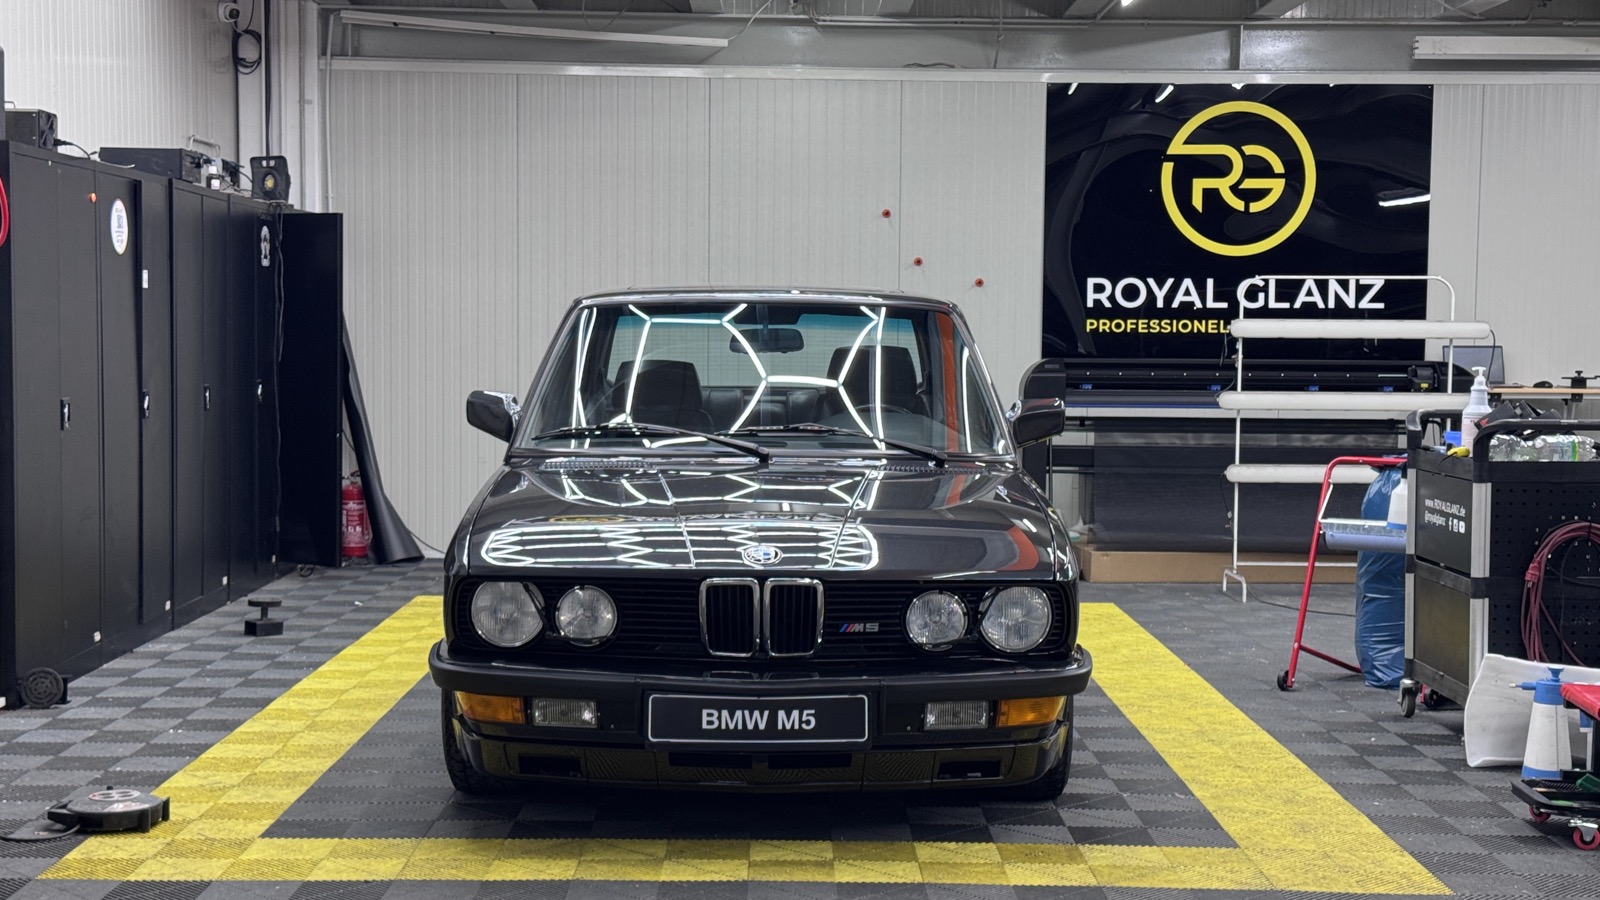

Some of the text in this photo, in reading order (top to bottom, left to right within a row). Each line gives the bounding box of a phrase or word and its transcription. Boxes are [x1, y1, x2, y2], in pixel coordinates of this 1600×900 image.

[1086, 277, 1386, 310] ROYAL GLANZ
[849, 622, 880, 633] M5
[701, 708, 817, 730] BMW M5
